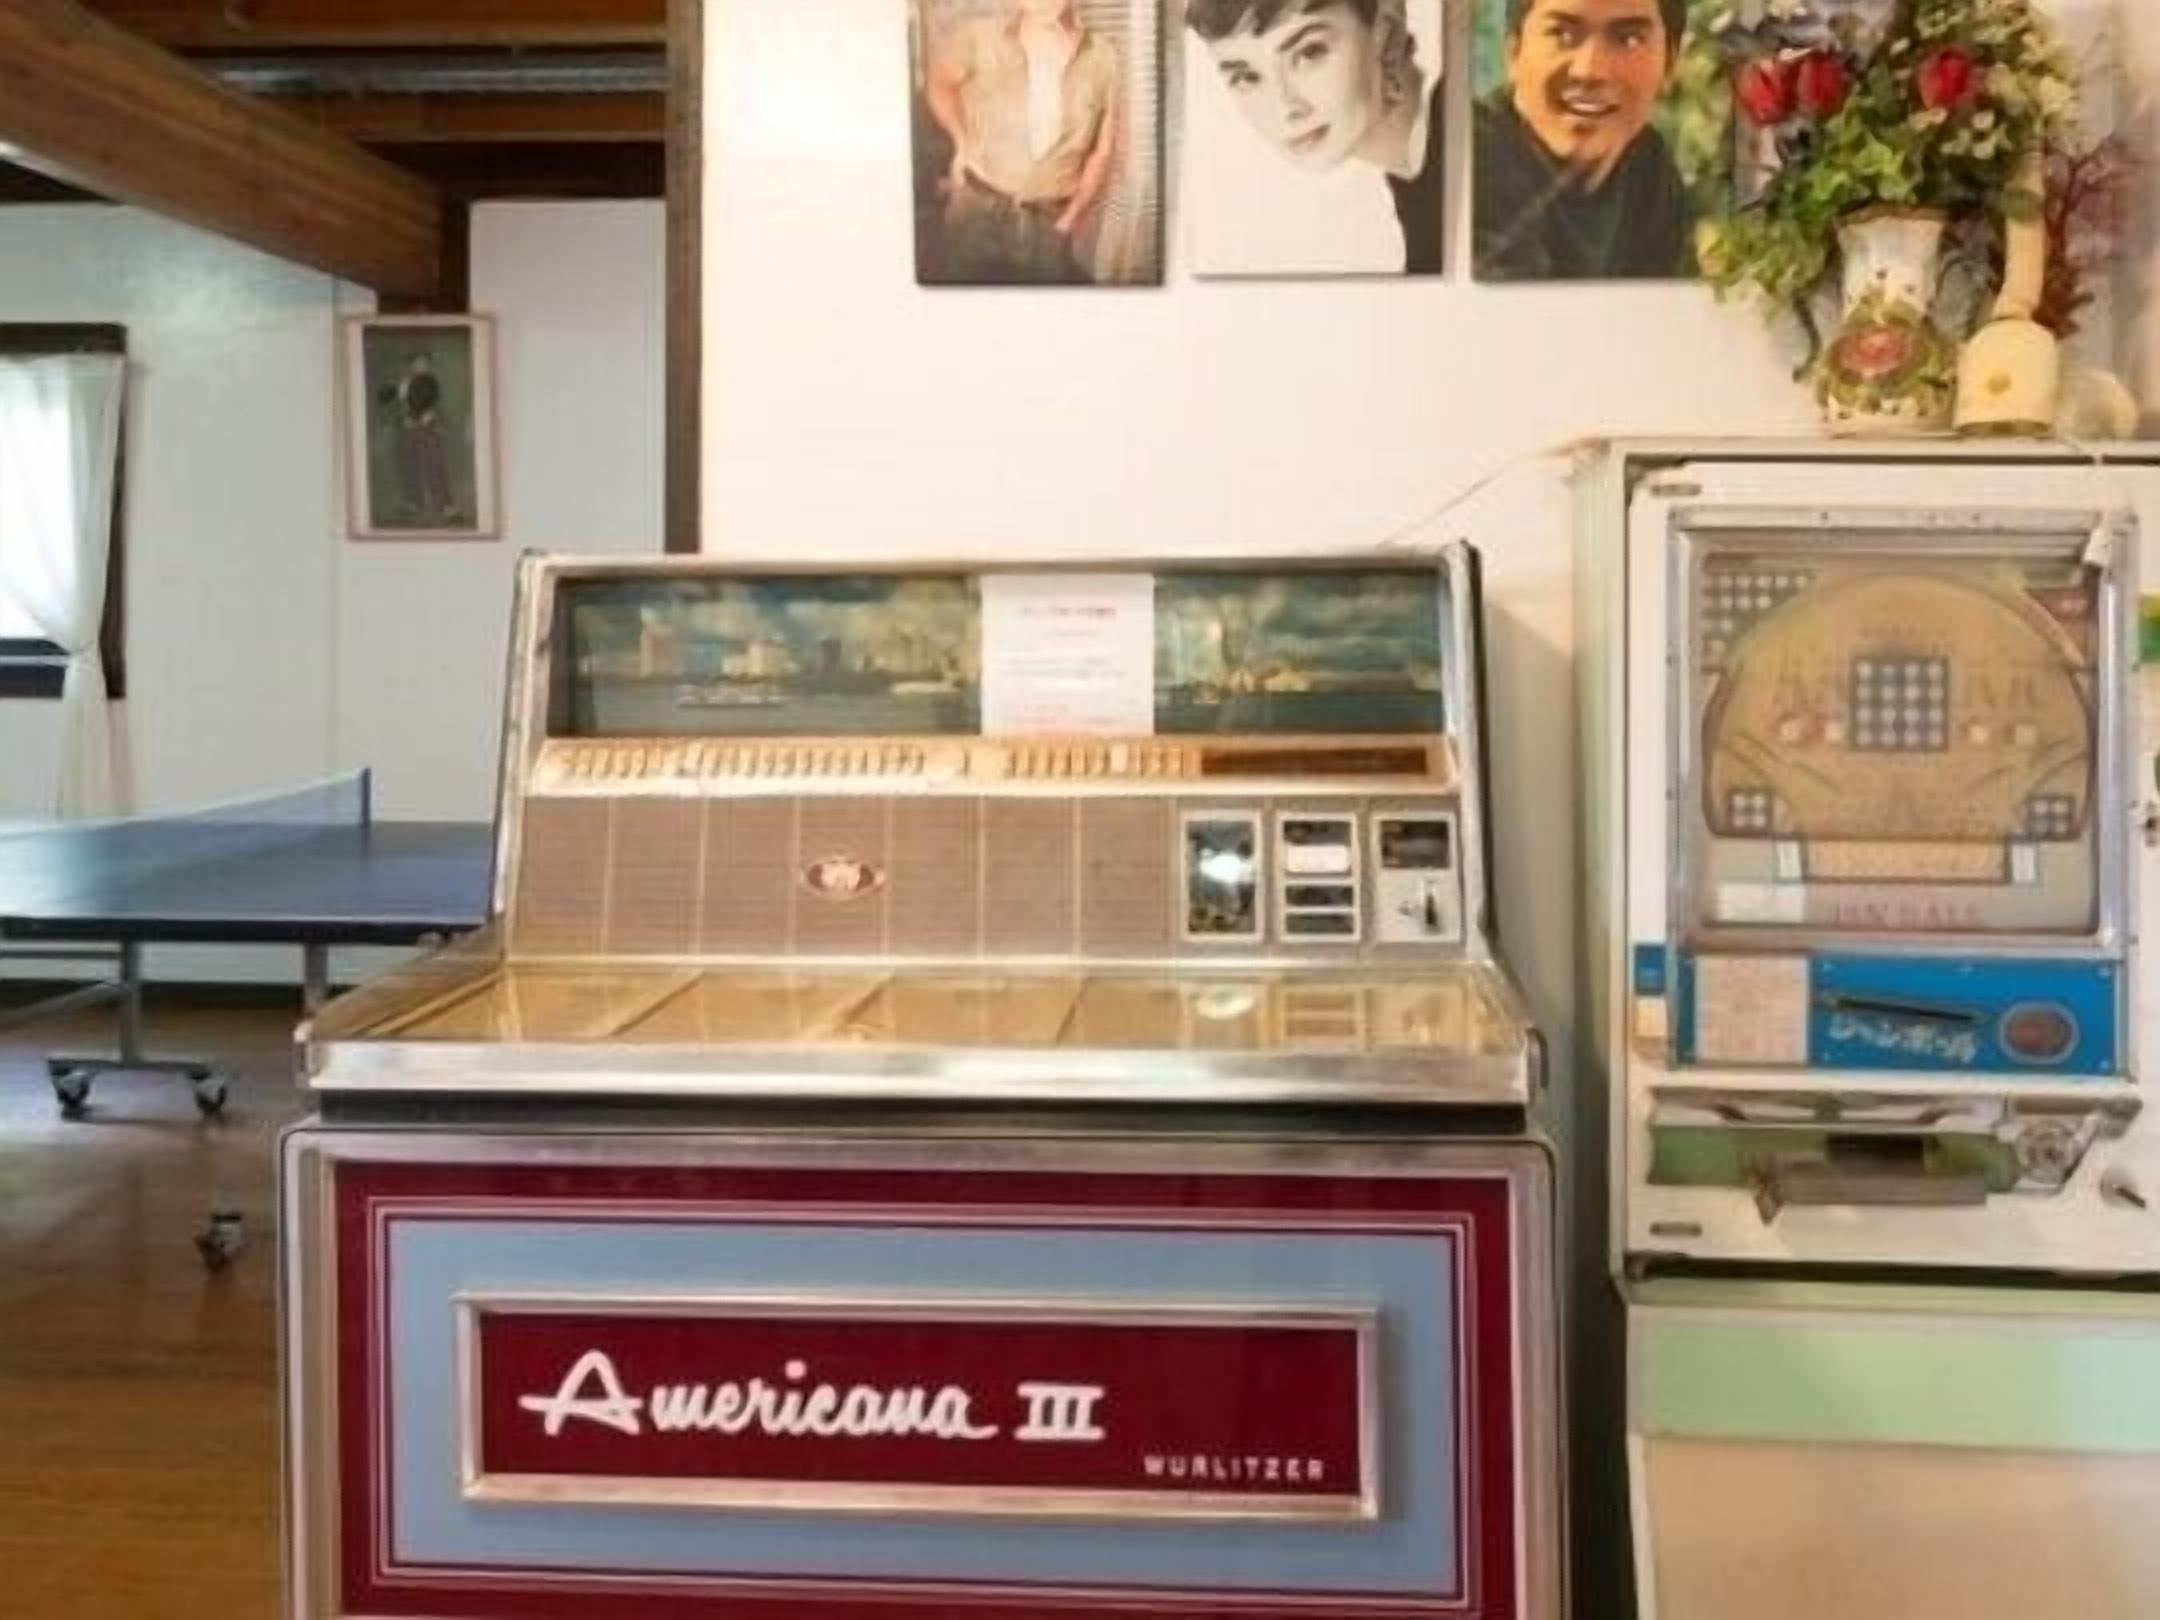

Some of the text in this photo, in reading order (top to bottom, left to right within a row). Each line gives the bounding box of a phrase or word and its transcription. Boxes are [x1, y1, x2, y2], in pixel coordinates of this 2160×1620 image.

[519, 1349, 1106, 1441] Americana III
[1144, 1454, 1324, 1481] WURLITZER
